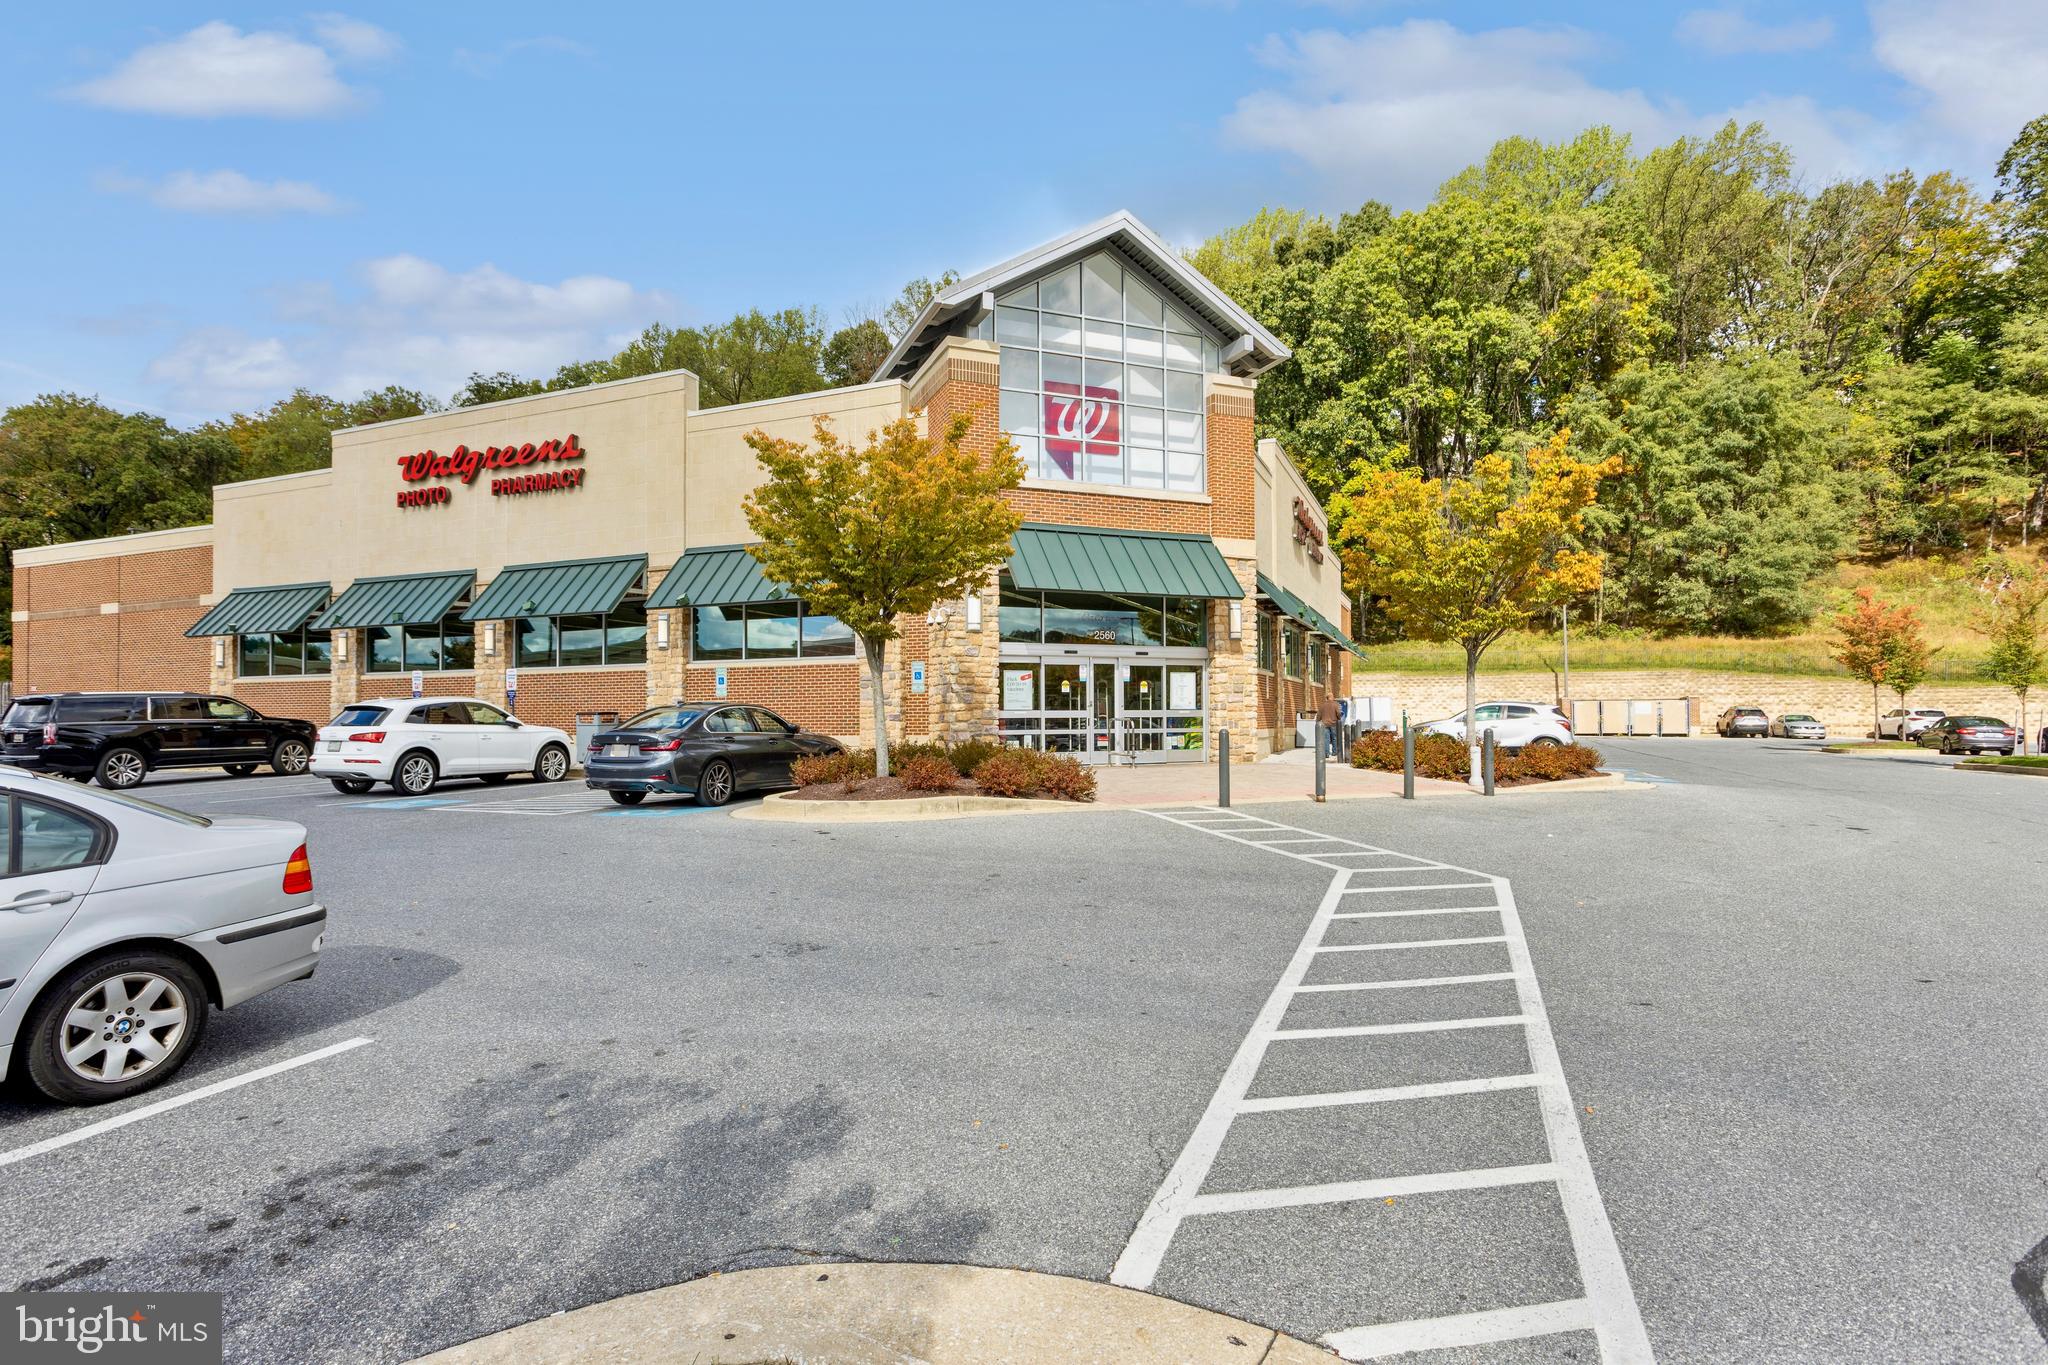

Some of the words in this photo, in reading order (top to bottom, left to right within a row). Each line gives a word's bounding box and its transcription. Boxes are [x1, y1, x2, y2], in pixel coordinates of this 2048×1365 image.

[397, 434, 585, 484] Walgreens
[397, 486, 451, 508] PHOTO
[491, 468, 585, 496] PHARMACY
[1094, 630, 1116, 640] 2560
